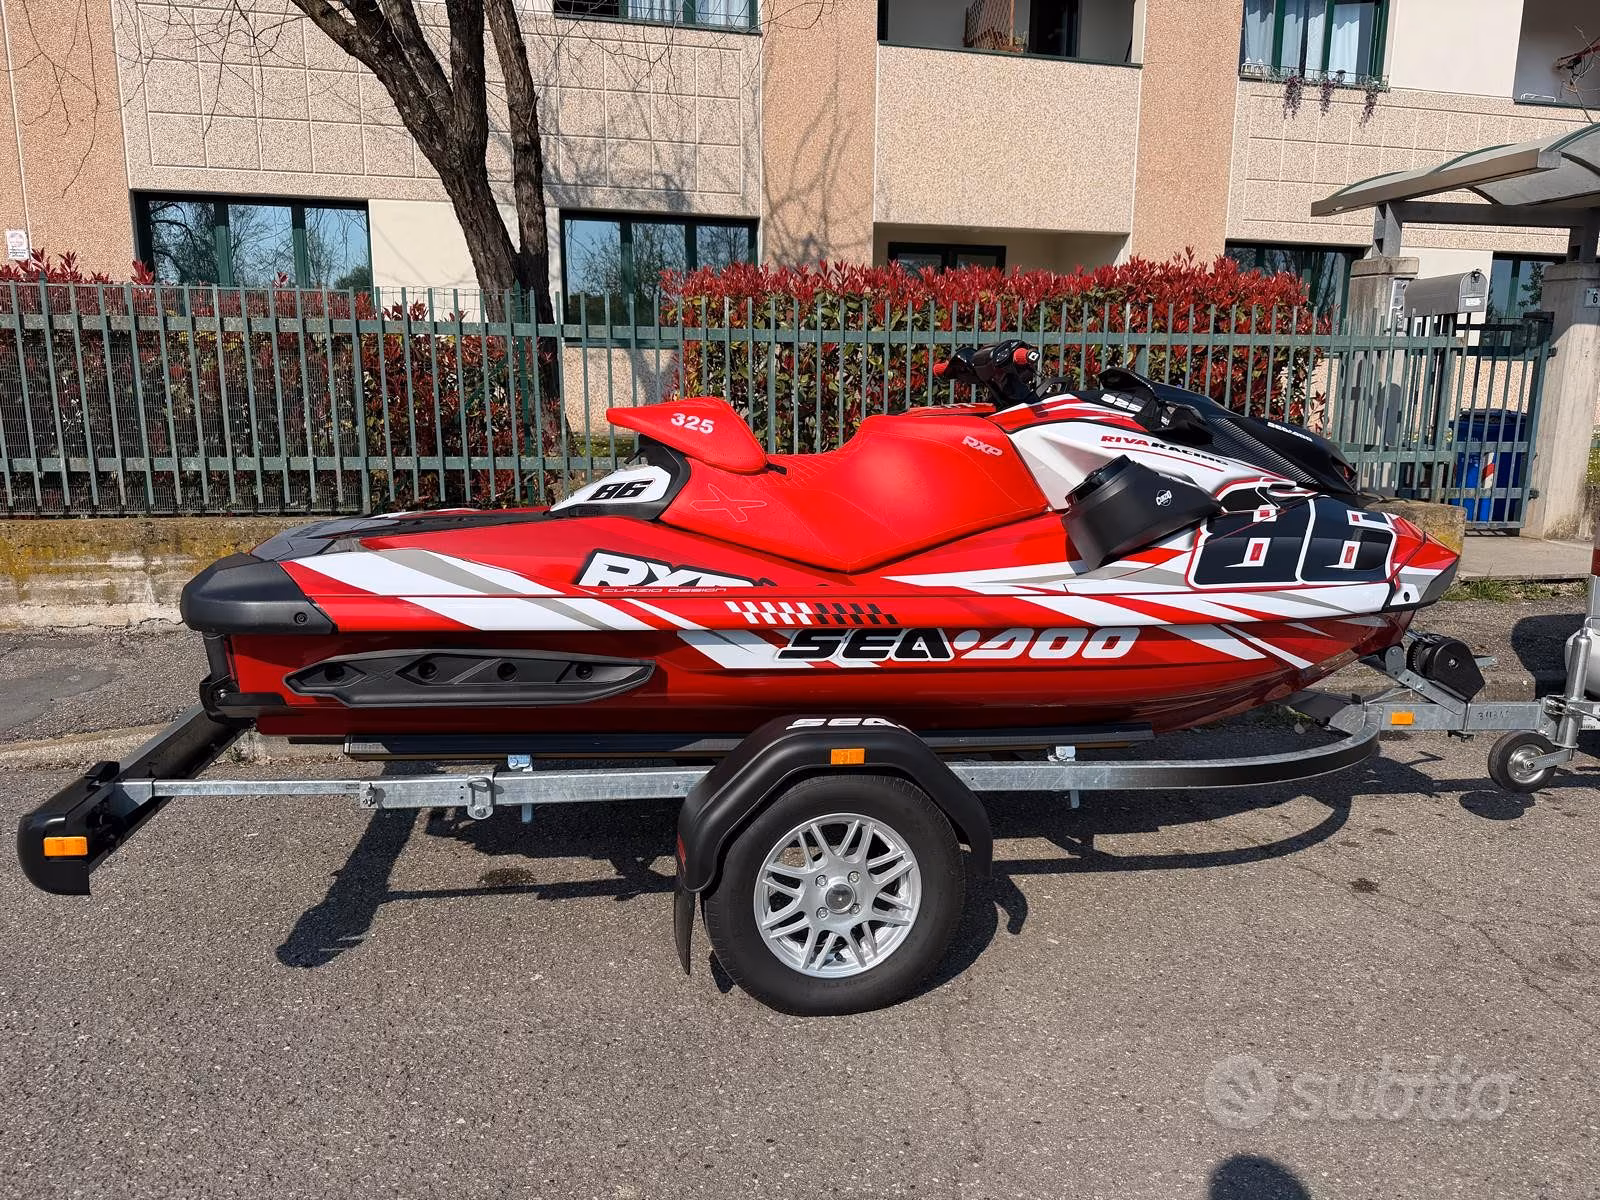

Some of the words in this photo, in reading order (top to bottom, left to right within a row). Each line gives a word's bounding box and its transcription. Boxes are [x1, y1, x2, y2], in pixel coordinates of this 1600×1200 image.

[671, 412, 715, 434] 325
[962, 435, 1003, 456] RXP
[586, 479, 656, 501] 86
